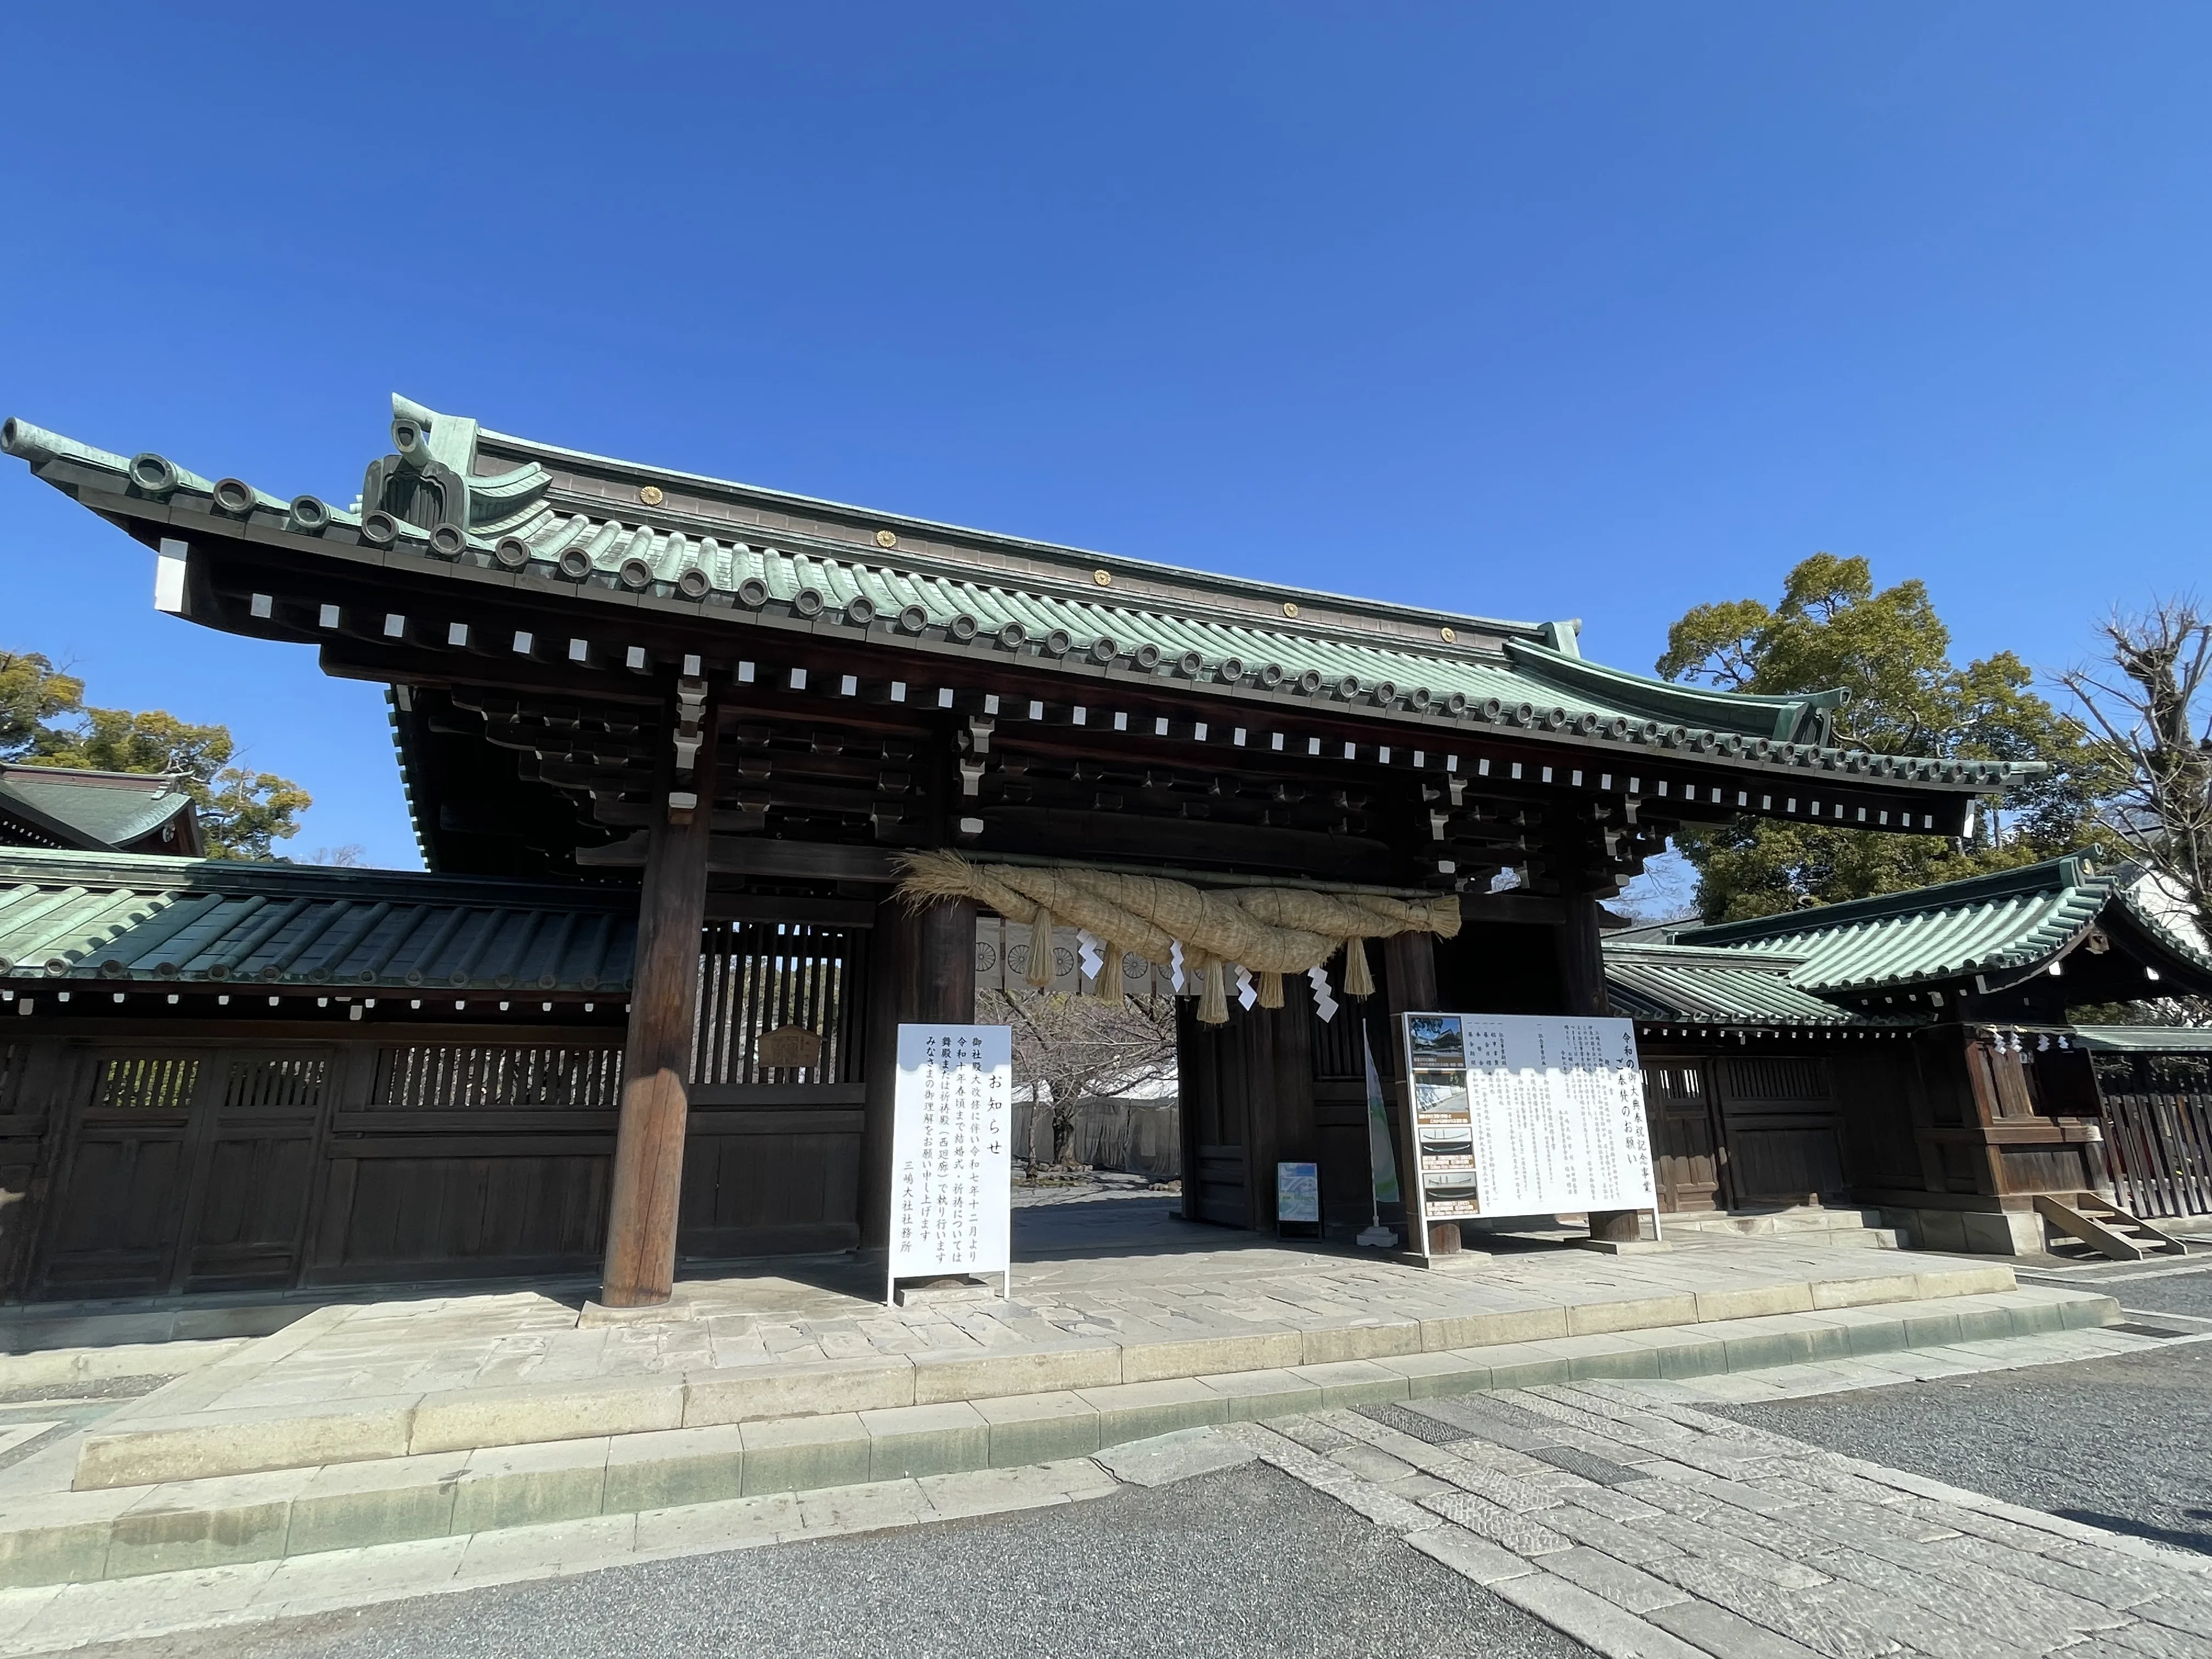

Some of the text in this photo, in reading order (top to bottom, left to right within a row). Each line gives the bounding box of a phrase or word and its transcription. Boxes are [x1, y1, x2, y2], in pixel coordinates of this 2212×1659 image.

[920, 1036, 935, 1242] みなさまの御理解をお願い申し上げます
[968, 1037, 982, 1262] 御社殿大改修に伴い令和七年十二月より
[986, 1074, 1002, 1154] お知らせ
[1622, 1031, 1651, 1193] 令和の御大典奉祝記念事業
[900, 1160, 913, 1252] 三嶋大社社務所
